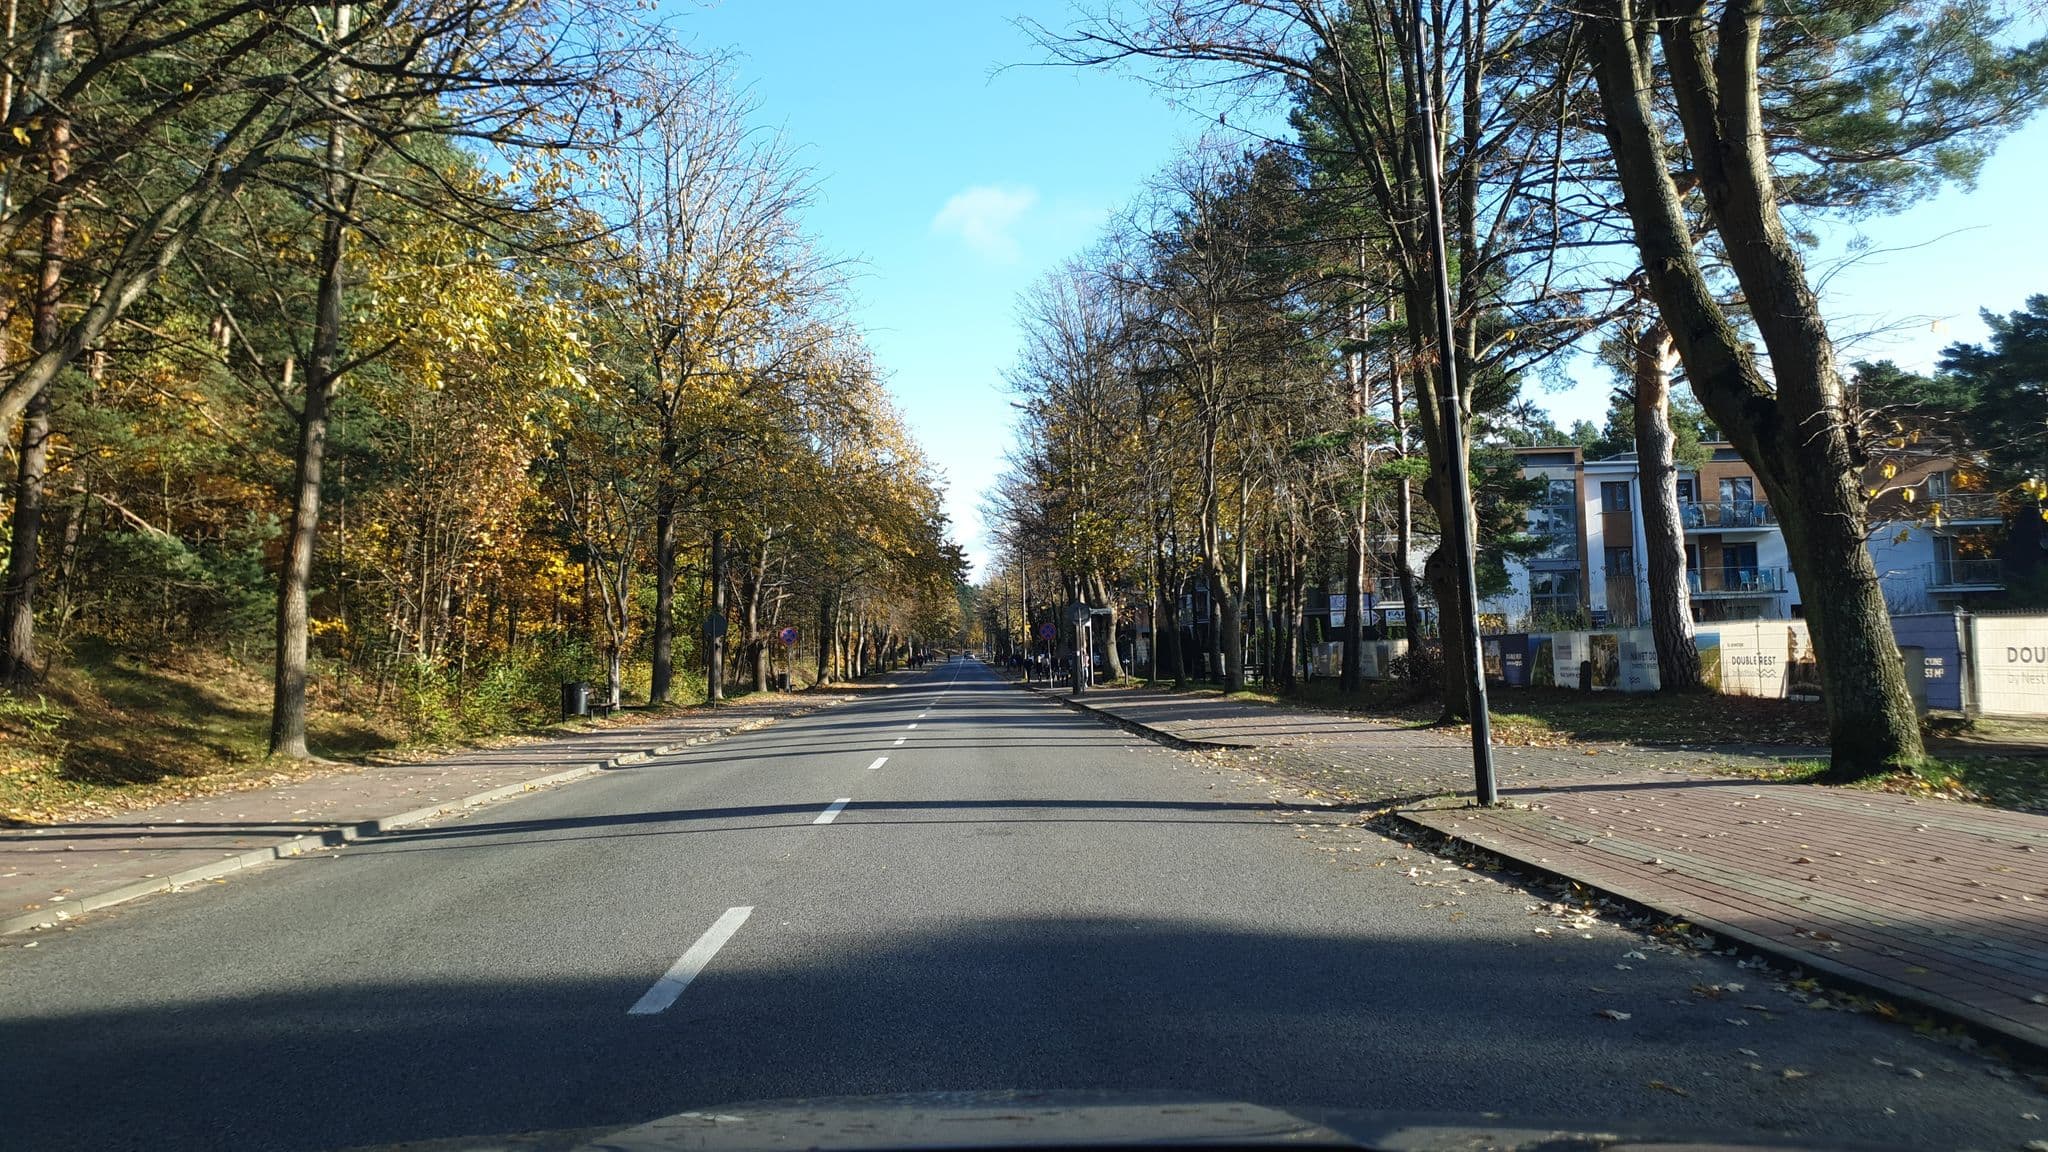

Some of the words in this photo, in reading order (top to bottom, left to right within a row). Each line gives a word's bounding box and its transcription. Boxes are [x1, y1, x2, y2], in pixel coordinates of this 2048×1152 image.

[2007, 646, 2048, 663] DOU
[1731, 656, 1757, 666] DOUBLE
[1758, 656, 1776, 665] REST
[1924, 668, 1933, 678] 53
